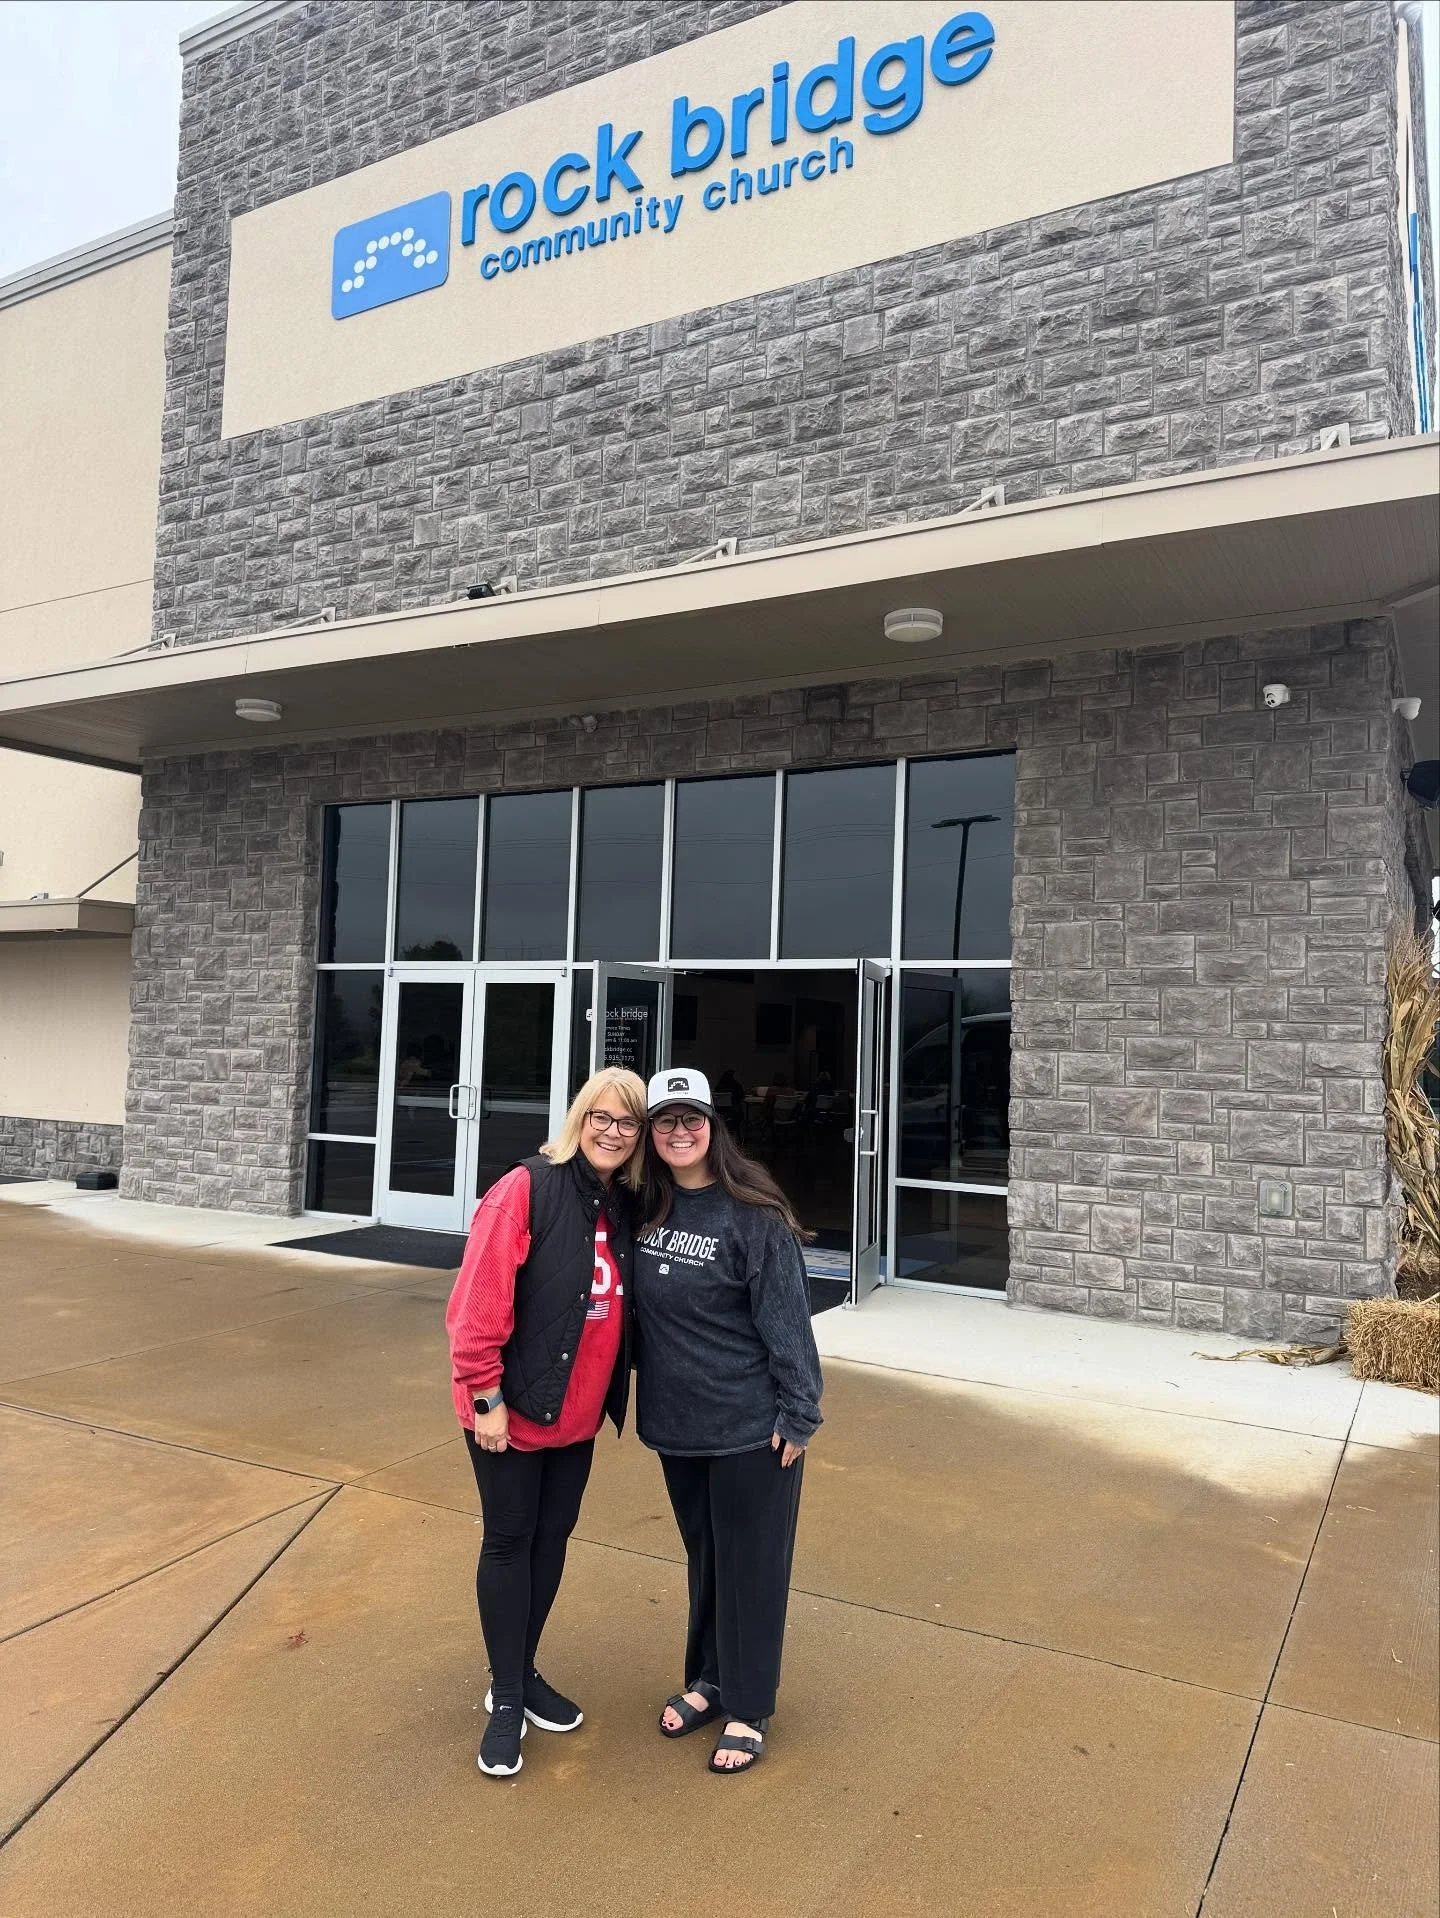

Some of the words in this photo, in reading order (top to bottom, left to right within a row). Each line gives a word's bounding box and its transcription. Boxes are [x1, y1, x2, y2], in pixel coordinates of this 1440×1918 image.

[461, 122, 644, 246] rock
[670, 11, 996, 178] bridge
[479, 190, 685, 280] community
[703, 134, 855, 211] church
[606, 1008, 619, 1017] ock
[621, 1008, 648, 1020] bridge
[640, 1246, 673, 1260] COMMUNITY
[674, 1256, 704, 1267] CHURCH
[666, 1230, 719, 1261] BRIDGE
